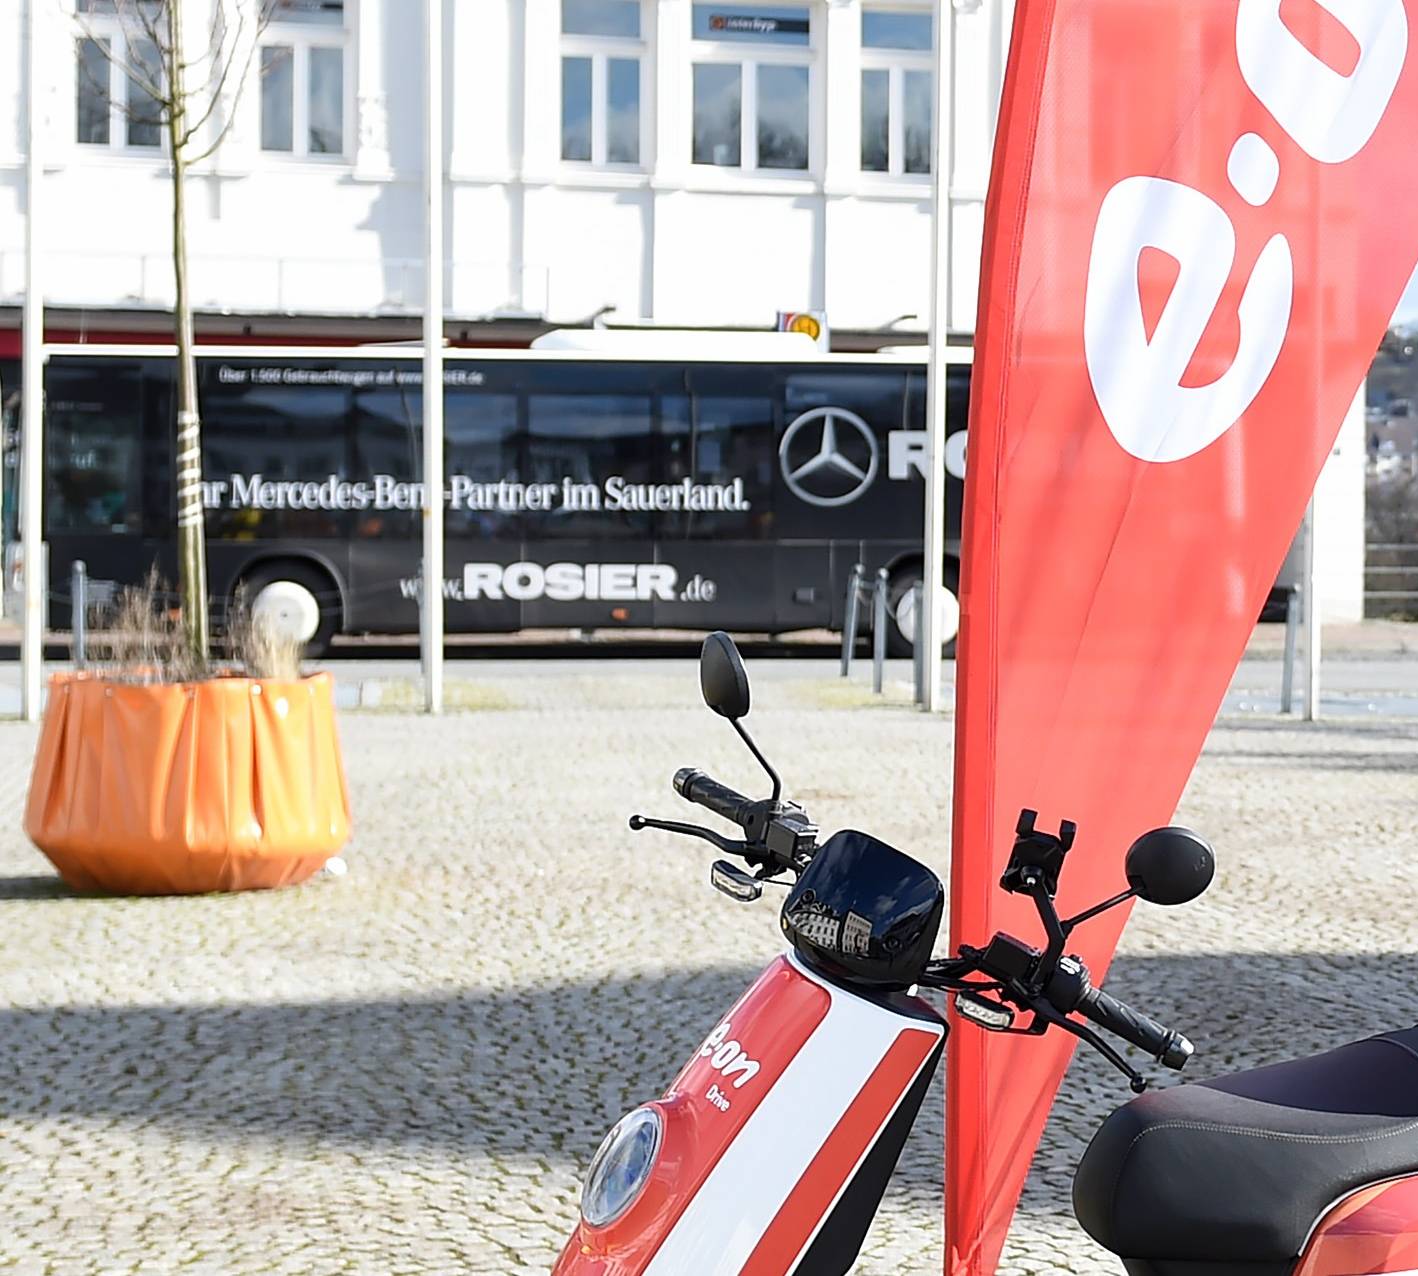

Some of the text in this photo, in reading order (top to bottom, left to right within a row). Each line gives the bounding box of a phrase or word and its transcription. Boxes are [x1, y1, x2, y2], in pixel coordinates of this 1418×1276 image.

[231, 474, 556, 510] Mercedes-Ben-Partner
[562, 477, 599, 511] im
[604, 476, 750, 511] Sauerland.
[400, 562, 715, 601] ww.ROSIER.de
[706, 1084, 730, 1112] Drive
